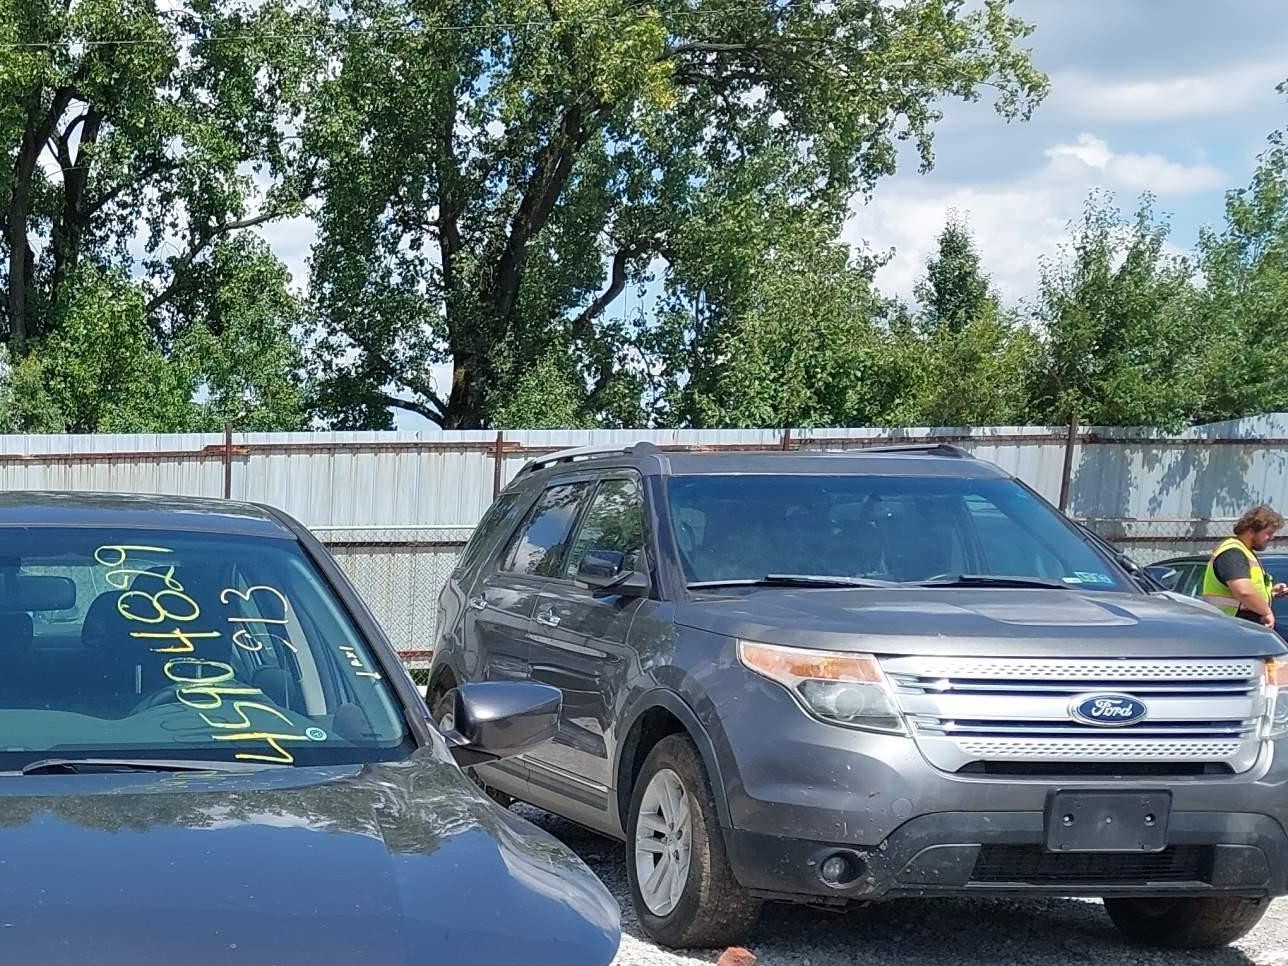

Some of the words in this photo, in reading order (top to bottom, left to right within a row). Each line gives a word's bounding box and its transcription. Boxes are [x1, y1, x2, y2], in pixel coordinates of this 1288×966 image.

[220, 585, 298, 653] 913
[94, 545, 313, 763] 45904829
[1091, 699, 1133, 717] Ford
